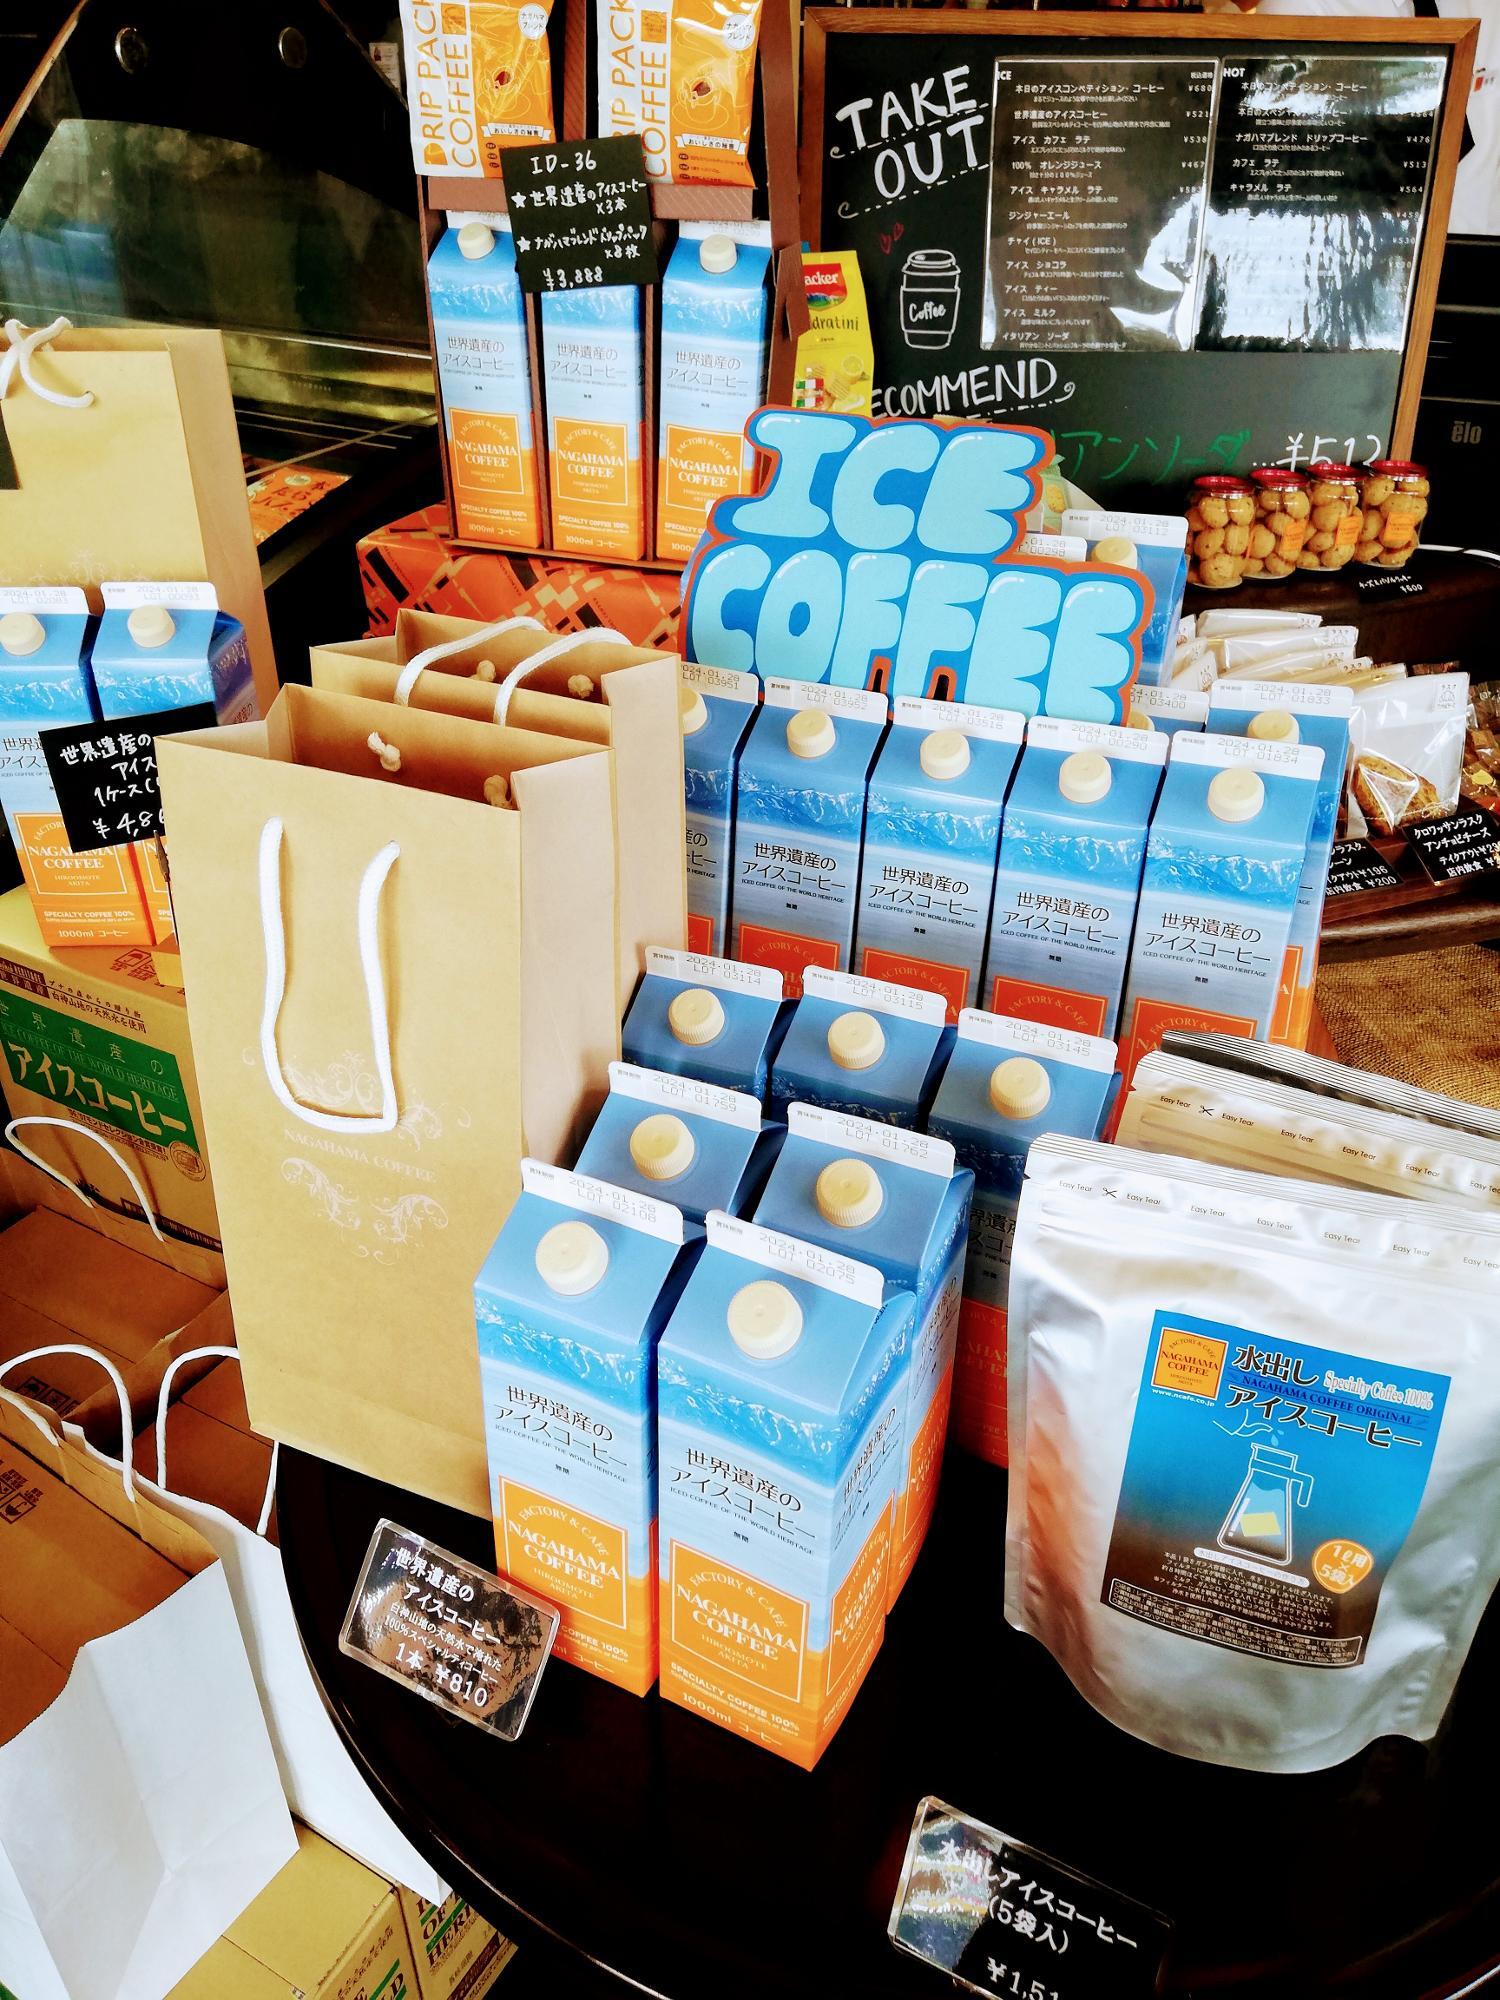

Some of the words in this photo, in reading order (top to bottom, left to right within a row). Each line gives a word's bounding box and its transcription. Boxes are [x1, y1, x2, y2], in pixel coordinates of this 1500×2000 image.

[1133, 84, 1165, 93] コーヒー
[1222, 68, 1246, 78] HOT
[445, 43, 477, 168] COFFEE
[641, 52, 667, 178] COFFEE
[835, 65, 976, 148] TAKE
[419, 91, 448, 166] DRIP
[1012, 135, 1036, 145] アイス
[1043, 135, 1066, 145] カフェ
[1075, 135, 1091, 145] ラテ
[1235, 133, 1298, 143] ナガハマブレンド
[1306, 134, 1368, 143] ドリップコーヒー
[530, 150, 597, 174] ID-36
[874, 114, 984, 198] OUT
[1232, 159, 1255, 168] カフェ
[1264, 159, 1280, 168] ラテ
[1010, 186, 1033, 195] アイス
[1087, 186, 1103, 195] ラテ
[1230, 183, 1268, 193] キャラメル
[1276, 183, 1292, 193] ラテ
[543, 266, 603, 290] ¥3,888
[804, 271, 839, 286] acker
[1006, 261, 1028, 270] アイス
[1005, 285, 1027, 293] アイス
[811, 315, 860, 332] dratini
[909, 301, 946, 323] Coffee
[1003, 308, 1026, 317] アイス
[1033, 308, 1056, 317] ミルク
[447, 336, 504, 353] 世界遺産の
[1002, 332, 1040, 341] イタリアン
[1047, 331, 1070, 341] ソーダ
[442, 352, 514, 371] アイスコーヒー
[676, 351, 741, 371] 世界遺産の
[667, 367, 749, 388] アイスコーヒー
[870, 357, 1058, 419] ECOMMEND
[455, 439, 519, 456] NAGAHAMA
[465, 454, 510, 468] COFFEE
[1058, 429, 1250, 484] アンソーダ
[669, 457, 739, 477] NAGAHAMA
[678, 471, 728, 489] COFFEE
[731, 411, 1039, 555] ICE
[691, 543, 1137, 724] COFFEE
[60, 733, 152, 766] 世界遺産の
[94, 777, 161, 807] 1ケース(
[754, 842, 837, 871] 世界遺産の
[742, 860, 846, 892] アイスコーヒー
[882, 865, 969, 895] 世界遺産の
[868, 884, 978, 916] アイスコーヒー
[1017, 891, 1110, 922] 世界遺産の
[1002, 910, 1119, 943] アイスコーヒー
[1161, 912, 1261, 943] 世界遺産の
[1015, 931, 1039, 940] COFFEE
[1063, 940, 1085, 950] WORLD
[1085, 945, 1117, 956] HERITAGE
[1145, 932, 1271, 965] アイスコーヒー
[694, 963, 716, 976] LOT
[1012, 1031, 1036, 1043] LOT
[8, 1041, 188, 1136] アイスコーヒー
[284, 1128, 369, 1164] NAGAHAMA
[373, 1155, 436, 1183] COFFEE
[1342, 1146, 1359, 1157] Easy
[1359, 1150, 1377, 1160] Tear
[1127, 1192, 1143, 1203] Easy
[1144, 1196, 1161, 1205] Tear
[768, 1244, 795, 1262] LOT
[1162, 1351, 1219, 1371] NAGAHAMA
[1167, 1361, 1209, 1377] COFFEE
[1232, 1345, 1319, 1386] 水出し
[1242, 1376, 1308, 1401] NAGAHAMA
[1310, 1393, 1354, 1412] COFFEE
[1356, 1404, 1413, 1425] ORIGINAL
[1324, 1370, 1371, 1401] Specialty
[1371, 1383, 1404, 1403] Coffee
[1403, 1388, 1434, 1411] 100%
[506, 1385, 613, 1442] 世界遺産の
[1226, 1385, 1422, 1449] アイスコーヒー
[494, 1404, 628, 1466] アイスコーヒー
[685, 1448, 801, 1512] 世界遺産の
[670, 1466, 816, 1538] アイスコーヒー
[508, 1519, 621, 1580] NAGAHAMA
[396, 1547, 475, 1603] 世界遺産の
[523, 1544, 605, 1589] COFFEE
[404, 1583, 501, 1645] アイスコーヒー
[676, 1584, 798, 1654] NAGAHAMA
[692, 1609, 779, 1661] COFFEE
[396, 1642, 424, 1670] 1本
[435, 1663, 487, 1707] ¥810
[671, 1662, 725, 1697] SPECIALTY
[727, 1693, 768, 1718] COFFEE
[771, 1713, 800, 1732] 100%
[683, 1692, 732, 1724] 1000ml
[739, 1721, 783, 1747] コーヒー
[940, 1838, 1138, 1948] 水出しアイスコーヒー
[988, 1895, 1069, 1953] (5袋入)
